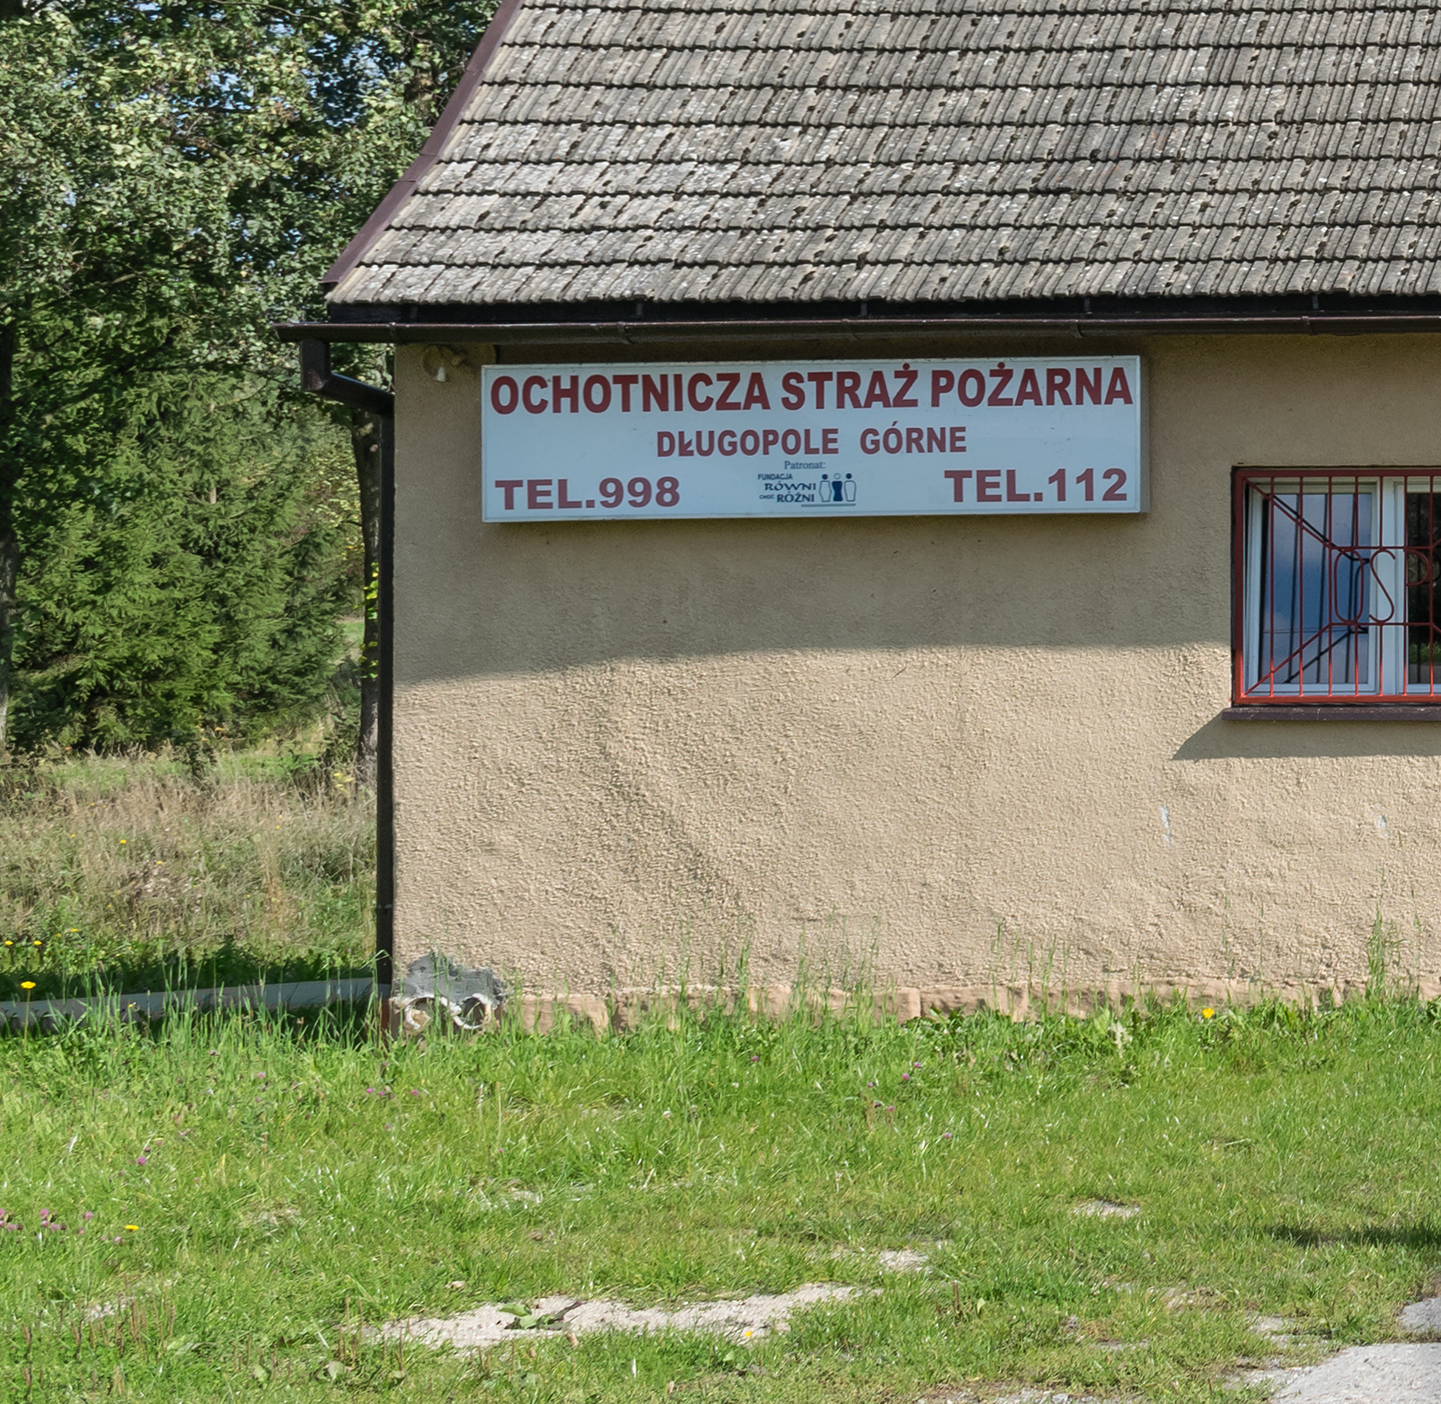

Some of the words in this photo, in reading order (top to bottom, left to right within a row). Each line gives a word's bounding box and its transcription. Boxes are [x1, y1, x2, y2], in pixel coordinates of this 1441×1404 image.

[490, 372, 771, 415] OCHOTNICZA
[780, 362, 919, 411] STRAŻ
[930, 361, 1134, 408] POŻARNA
[656, 428, 839, 457] DŁUGOPOLE
[859, 421, 967, 455] GÓRNE
[757, 473, 793, 481] FUNDACJA
[784, 460, 826, 470] Patronat:
[494, 476, 680, 511] TEL.998
[764, 480, 816, 491] RÓWNI
[944, 467, 1128, 503] TEL.112
[1333, 547, 1430, 625] OSP
